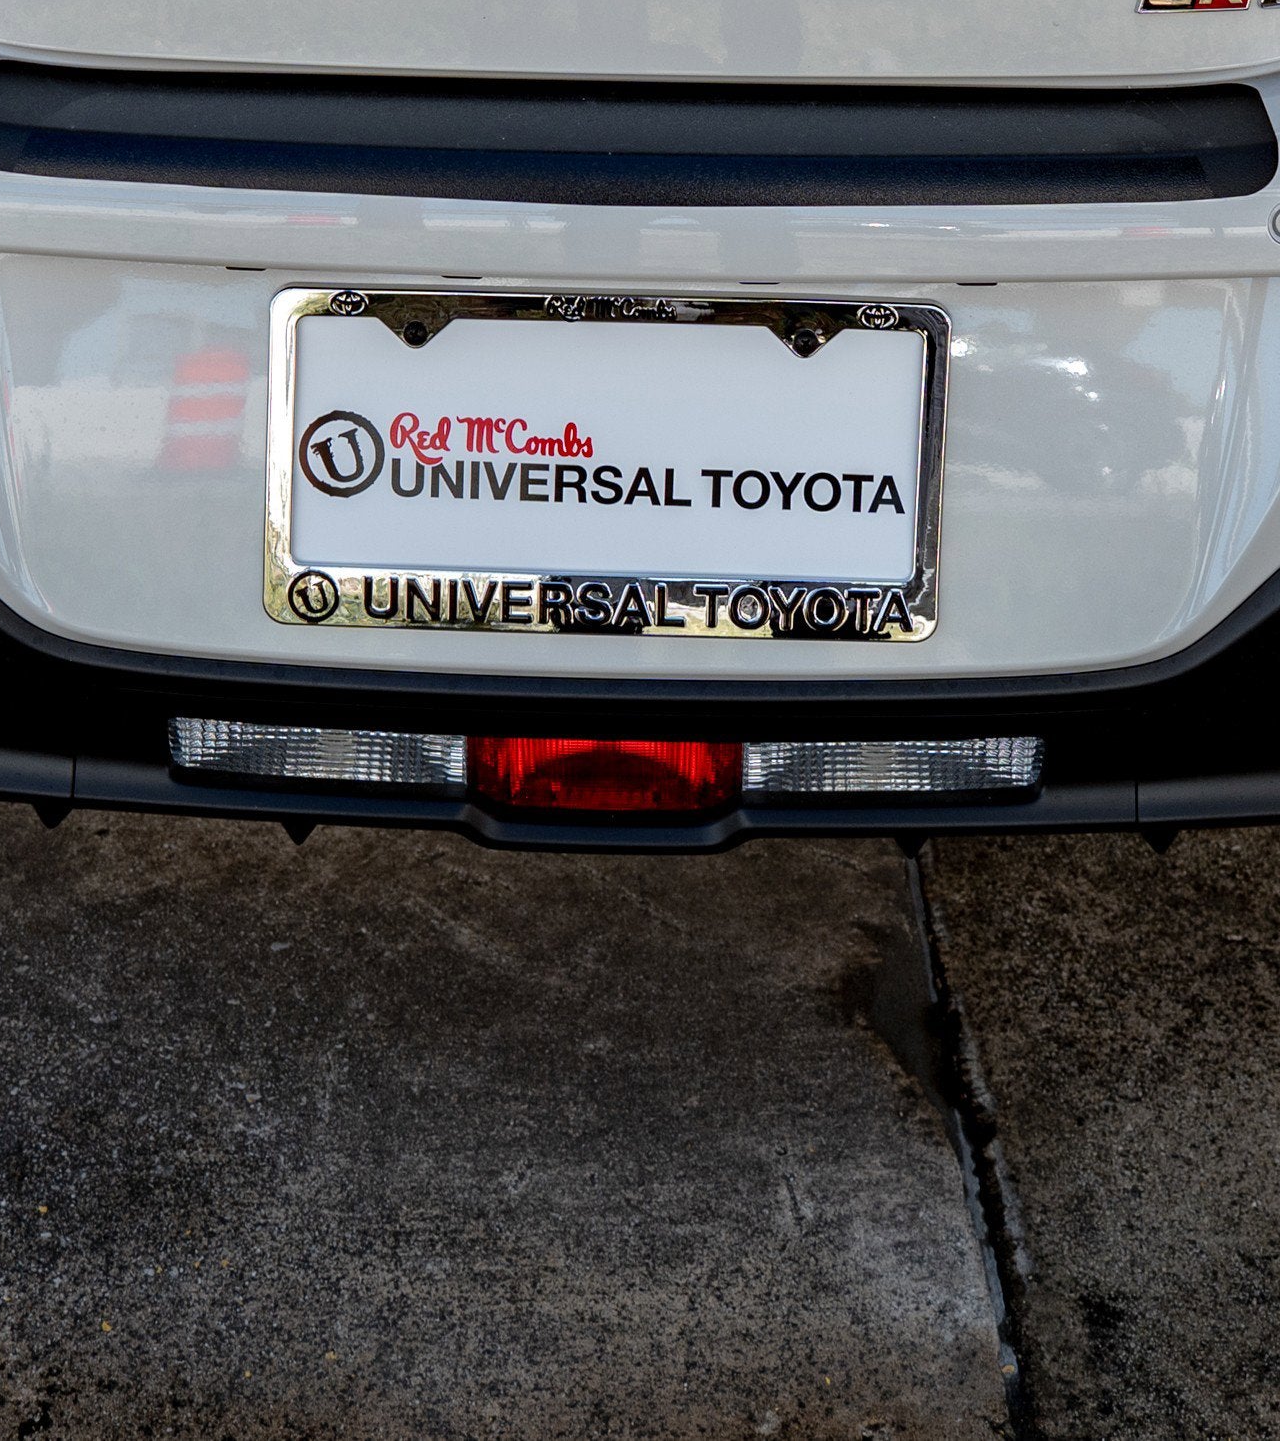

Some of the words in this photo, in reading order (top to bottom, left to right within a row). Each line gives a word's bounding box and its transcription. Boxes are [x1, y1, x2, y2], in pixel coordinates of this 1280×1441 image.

[545, 294, 586, 322] Red
[389, 411, 451, 466] Red
[456, 416, 594, 458] McCombs
[390, 457, 692, 507] UNIVERSAL
[700, 468, 906, 515] TOYOTA
[361, 574, 687, 629] UNIVERSAL
[692, 583, 915, 633] TOYOTA
